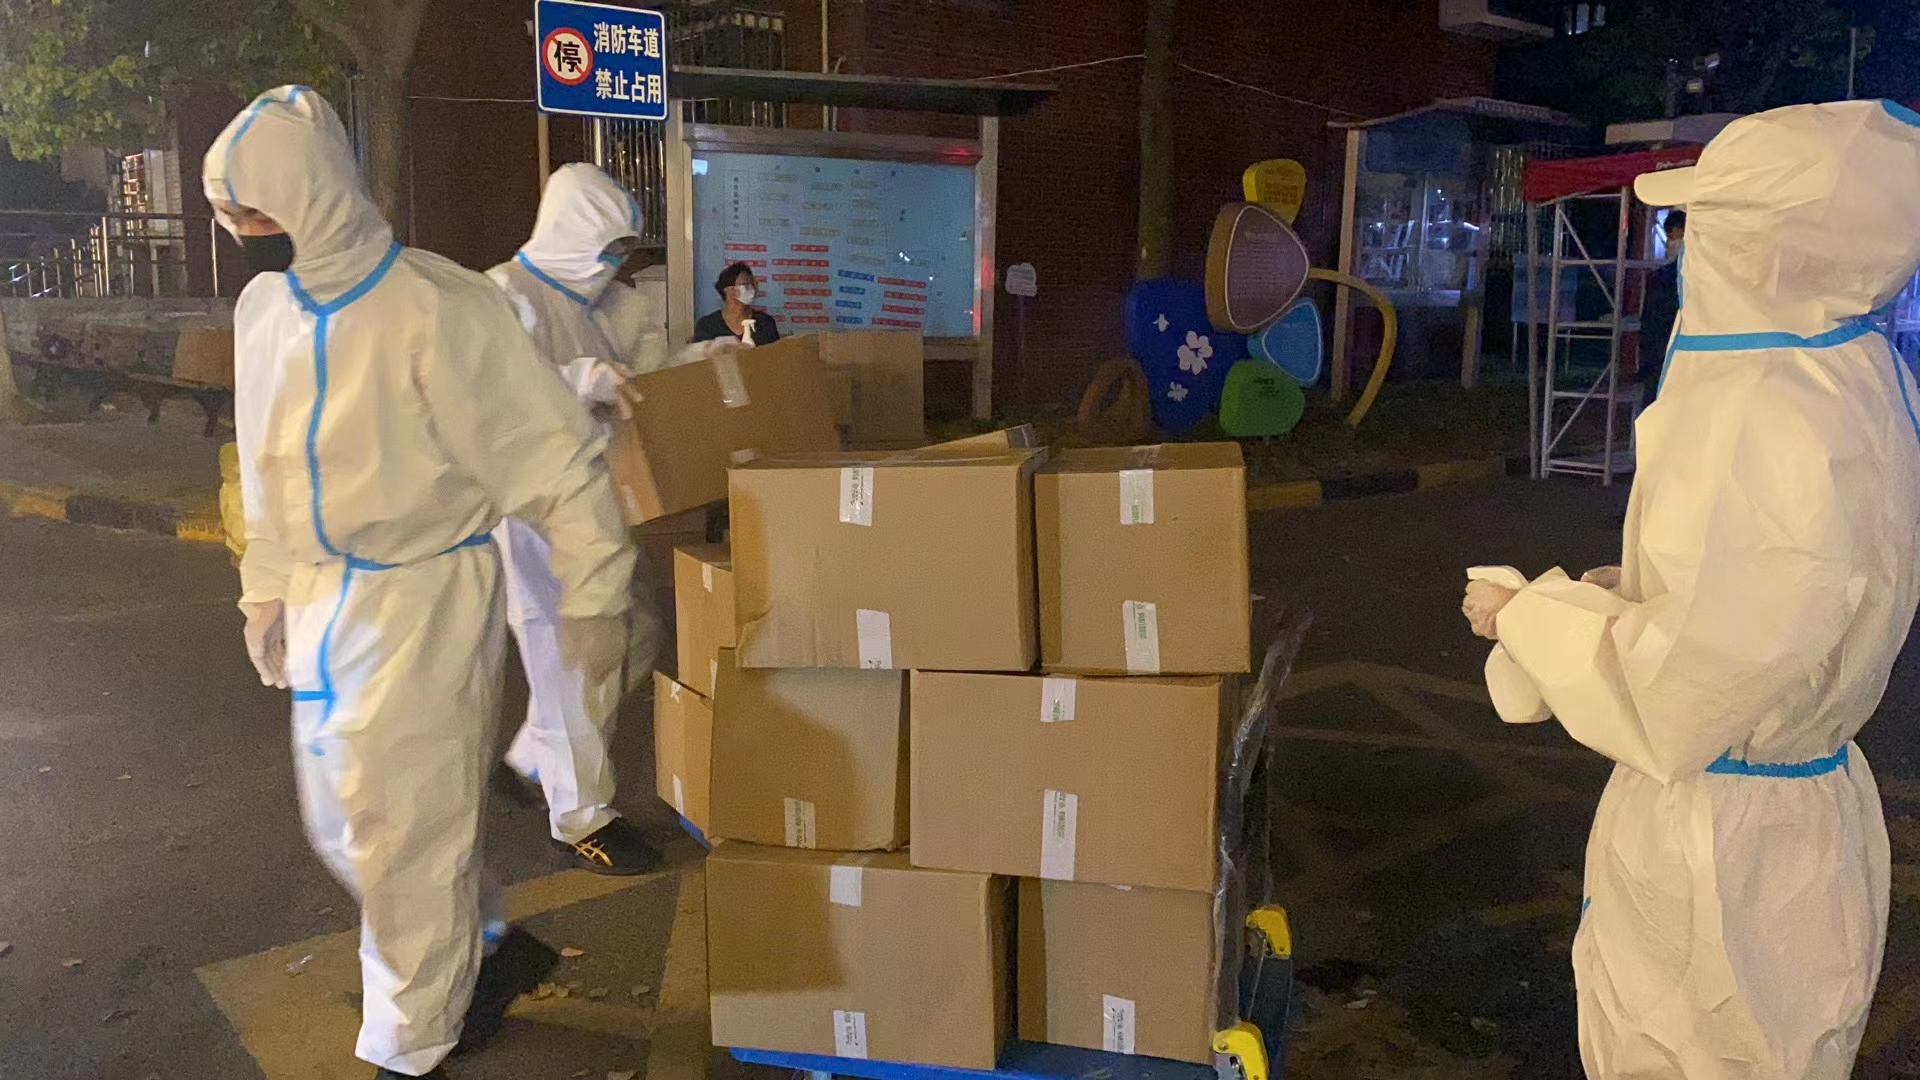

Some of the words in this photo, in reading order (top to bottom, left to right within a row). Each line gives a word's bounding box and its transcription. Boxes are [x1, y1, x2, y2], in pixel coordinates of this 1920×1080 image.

[553, 41, 582, 73] 停
[594, 22, 660, 58] 消防车道
[595, 68, 662, 104] 禁止占用
